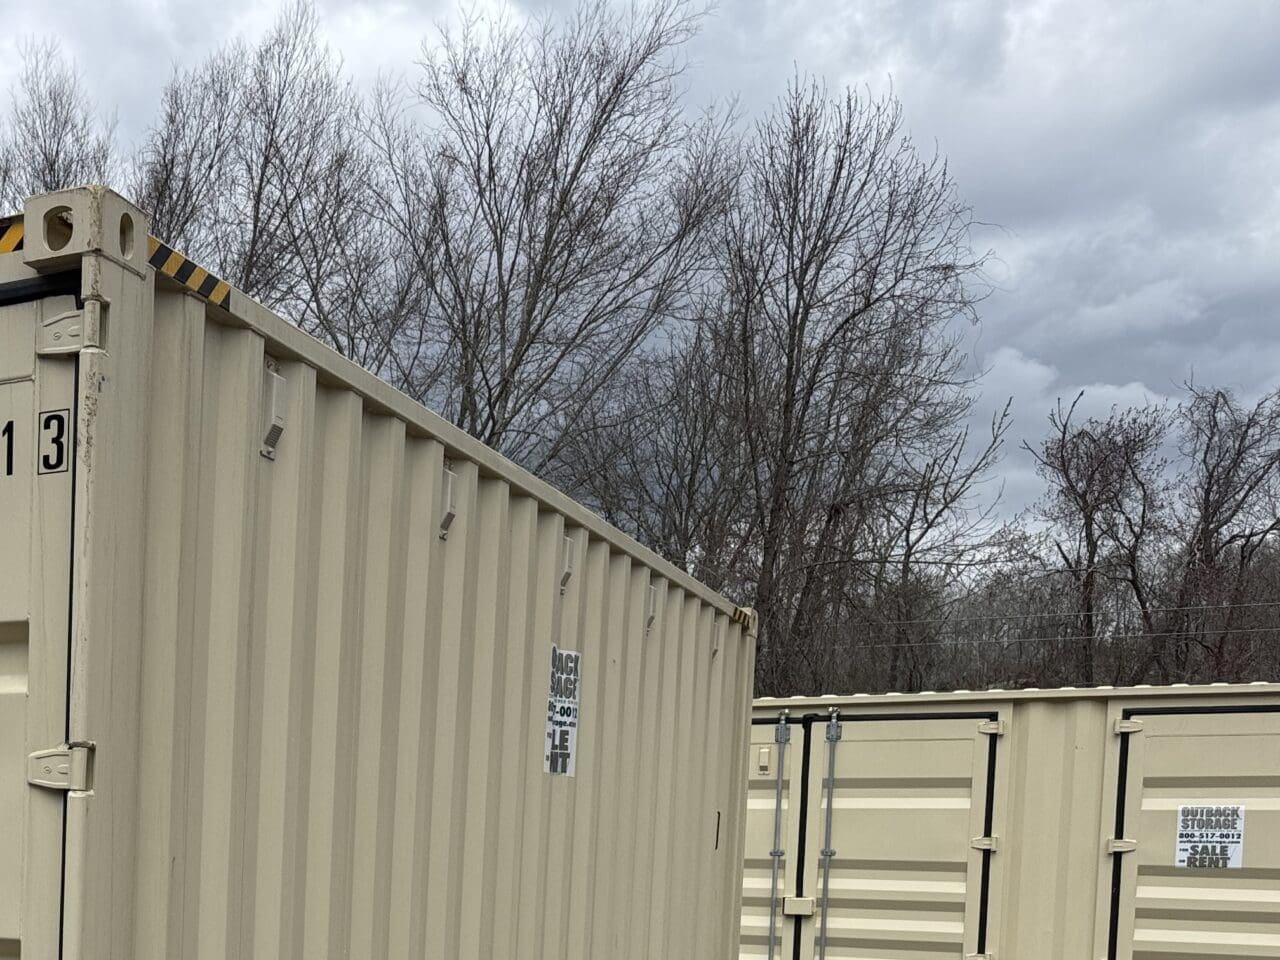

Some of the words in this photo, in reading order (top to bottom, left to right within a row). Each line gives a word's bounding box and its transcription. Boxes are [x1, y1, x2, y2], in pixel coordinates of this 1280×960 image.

[41, 413, 66, 471] 3
[1181, 806, 1240, 818] OUTBACK
[1181, 818, 1238, 830] STORAGE
[1189, 844, 1229, 857] SALE
[1186, 856, 1231, 868] RENT
